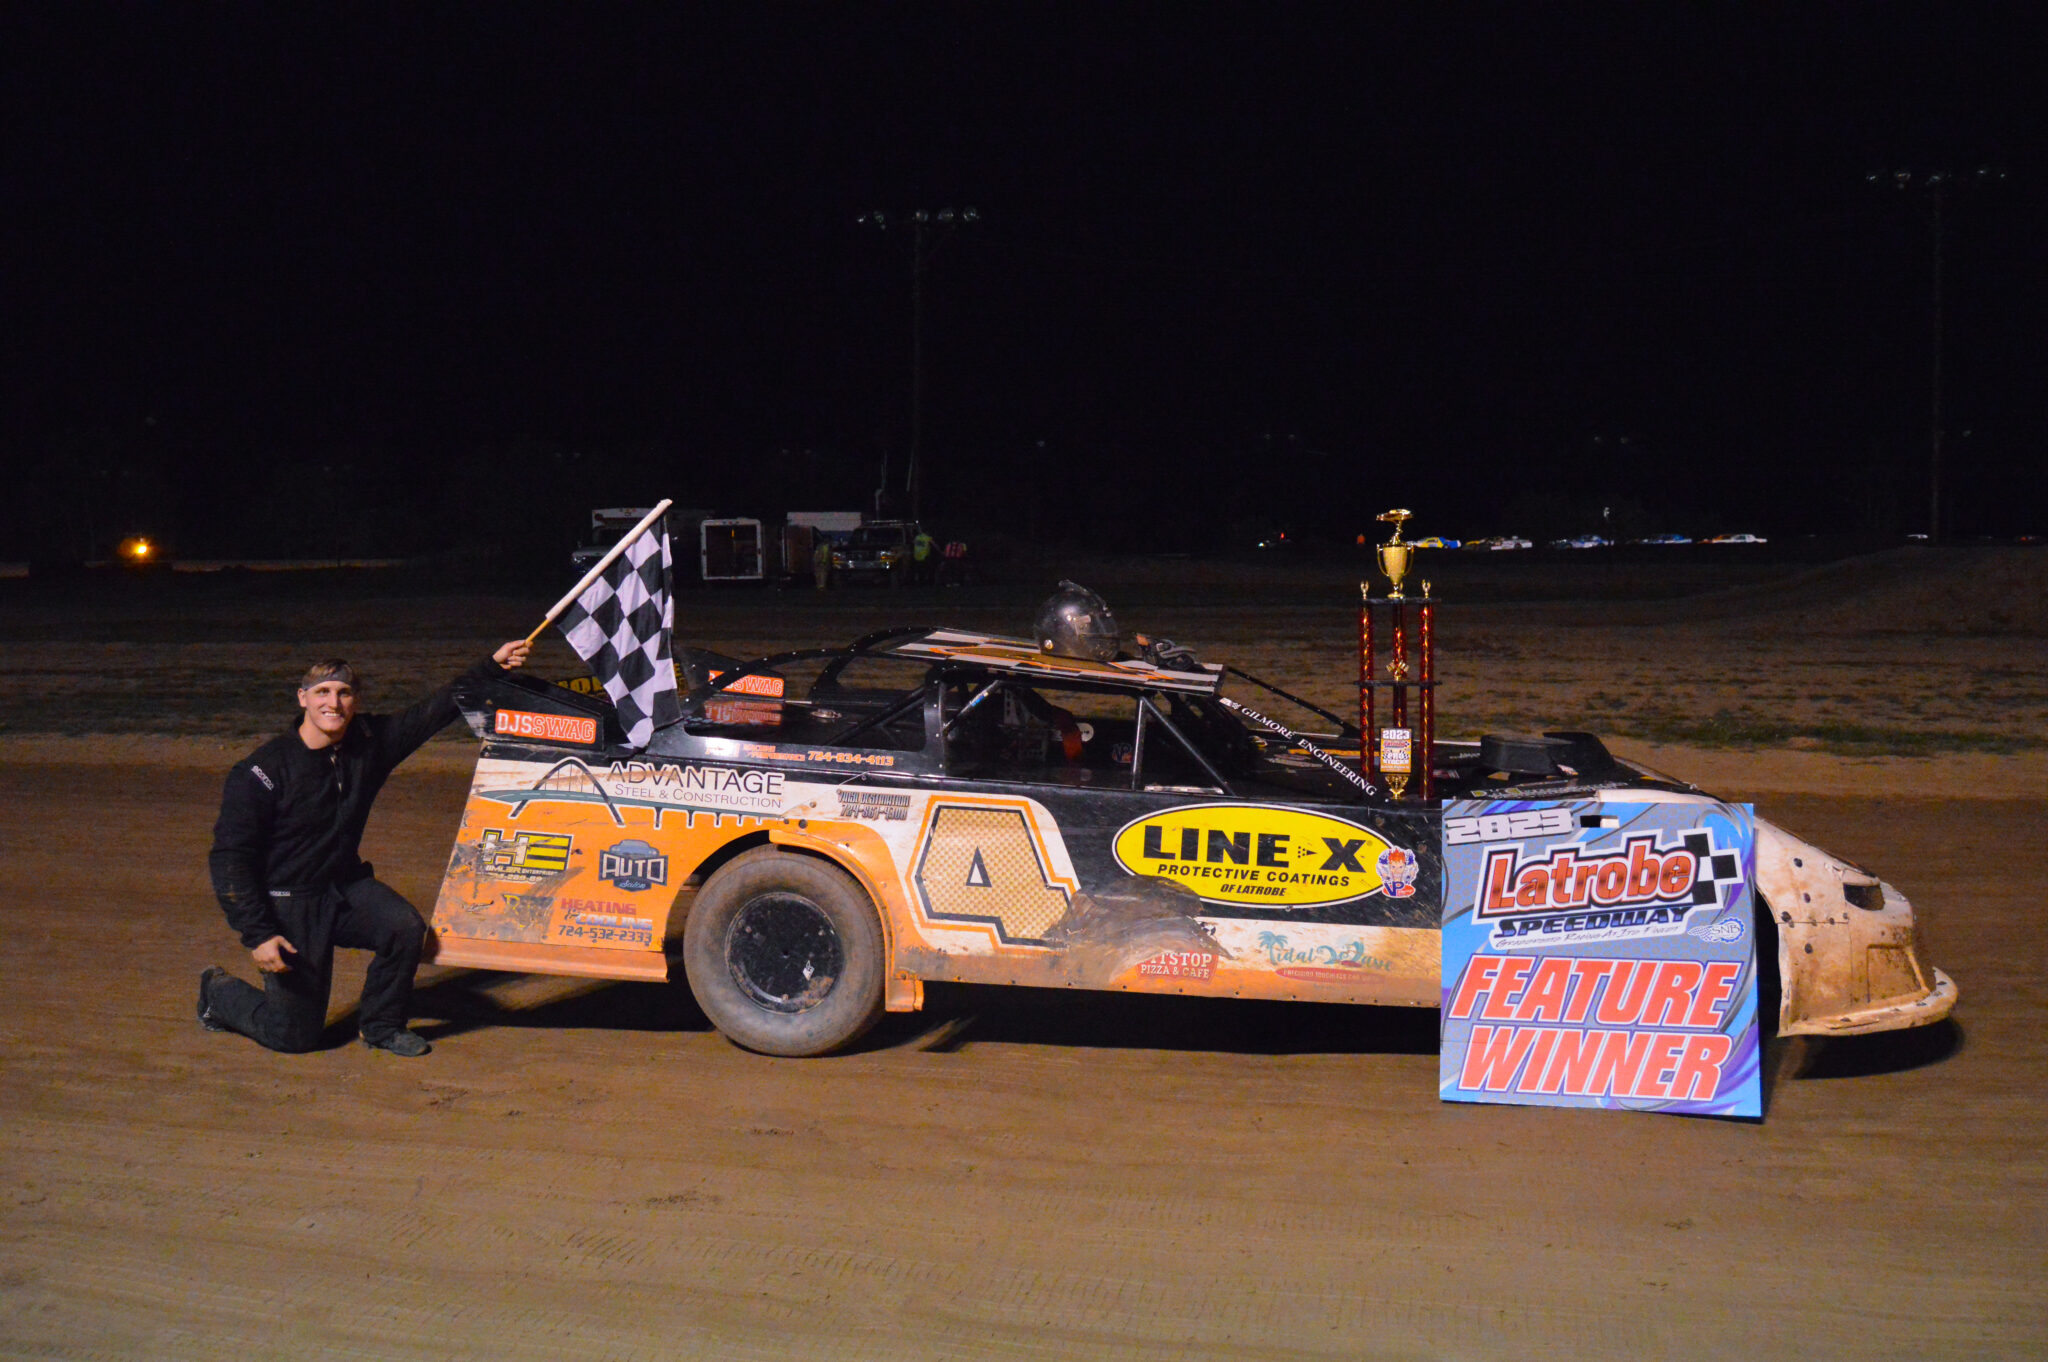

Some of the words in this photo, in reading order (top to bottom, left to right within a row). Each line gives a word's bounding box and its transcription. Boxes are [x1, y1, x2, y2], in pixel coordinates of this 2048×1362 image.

[1382, 729, 1410, 740] 2023
[1241, 707, 1296, 740] GILMORE
[1297, 738, 1378, 797] ENGINEERING
[606, 762, 783, 796] ADVANTAGE
[659, 789, 668, 799] &
[1445, 808, 1575, 845] 2023
[601, 853, 666, 884] AUTO
[1157, 864, 1260, 881] PROTECTIVE
[1267, 871, 1350, 887] COATINGS
[1484, 842, 1698, 911] Latrobe
[1220, 883, 1236, 893] OF
[1236, 885, 1287, 897] LATROBE
[1383, 881, 1405, 897] VP
[560, 898, 637, 915] HEATING
[576, 913, 653, 930] COOLING
[1493, 906, 1693, 938] SPEEDWAY
[558, 925, 653, 944] 724-532-2333
[1140, 964, 1170, 975] PIZZA
[1172, 966, 1180, 976] &
[1182, 967, 1210, 979] CAFE
[1448, 955, 1743, 1029] FEATURE
[1457, 1024, 1734, 1101] WINNER
